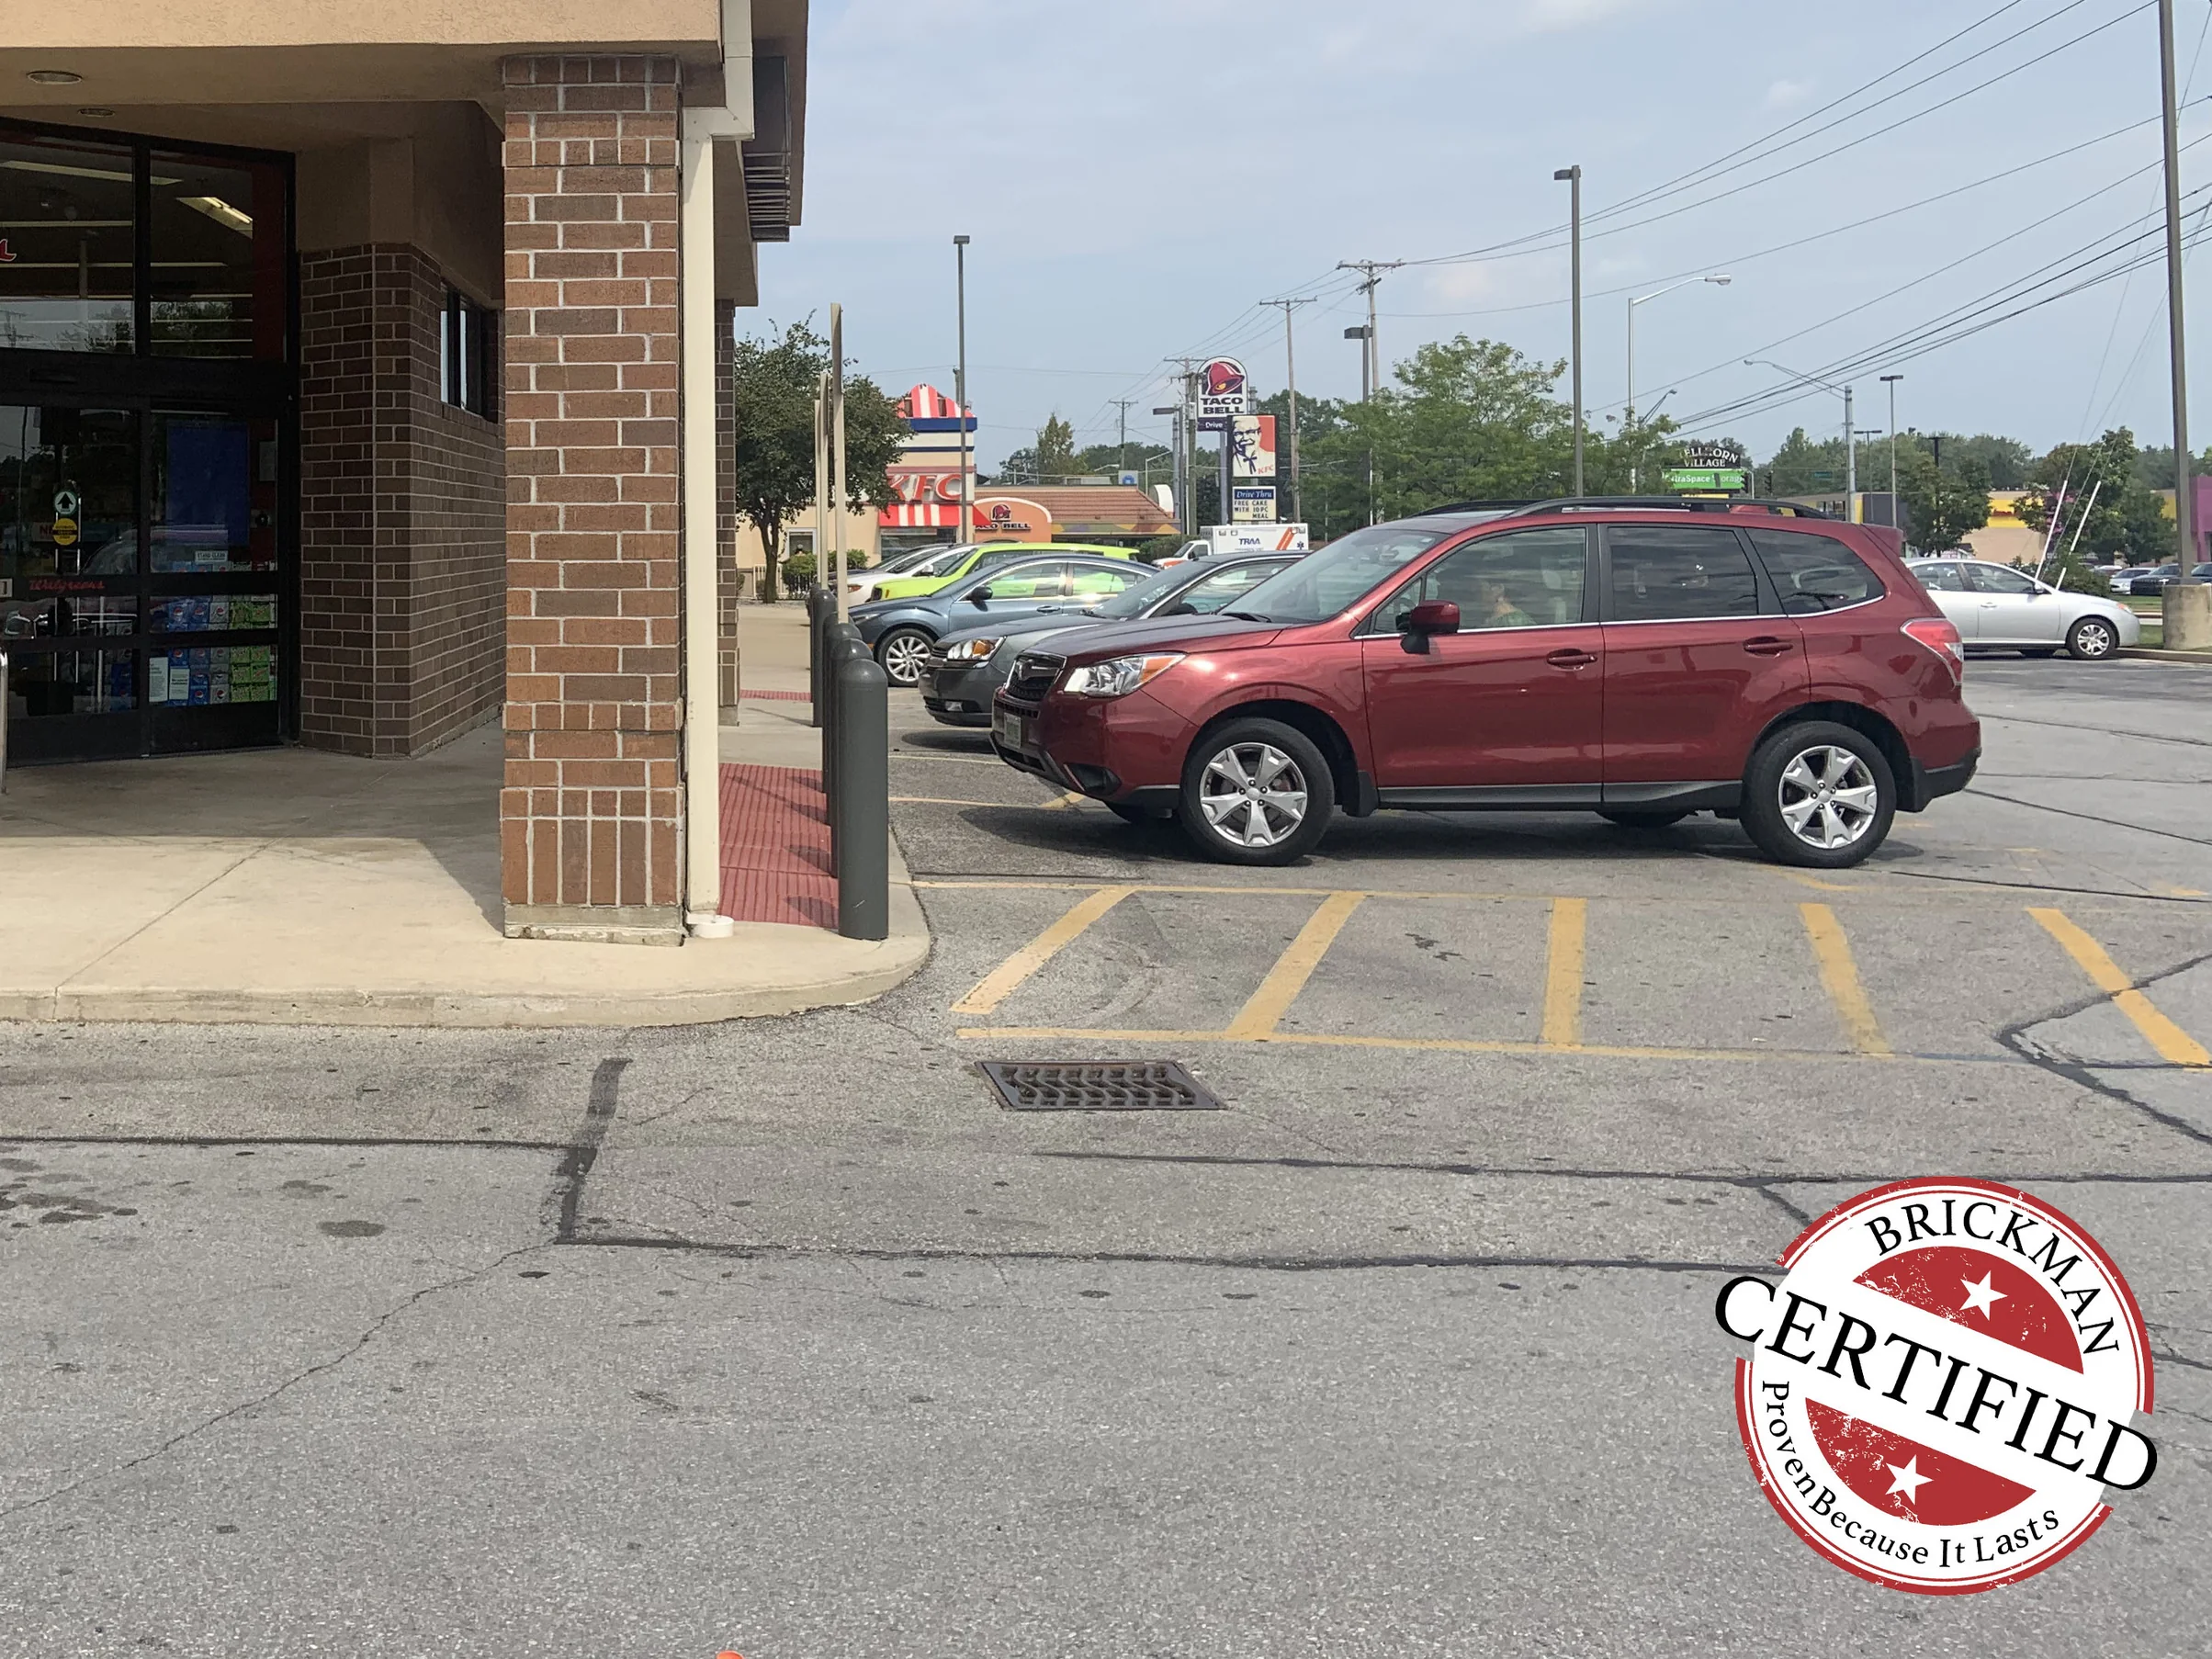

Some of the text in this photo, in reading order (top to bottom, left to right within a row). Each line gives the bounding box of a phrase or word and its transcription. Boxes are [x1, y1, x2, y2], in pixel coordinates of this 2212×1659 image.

[1202, 406, 1244, 414] BELL
[1684, 458, 1726, 468] VILLAGE
[1258, 464, 1274, 475] KFC
[887, 473, 962, 501] KFC
[1236, 490, 1272, 498] Drive Thru
[1238, 537, 1261, 546] TRAA
